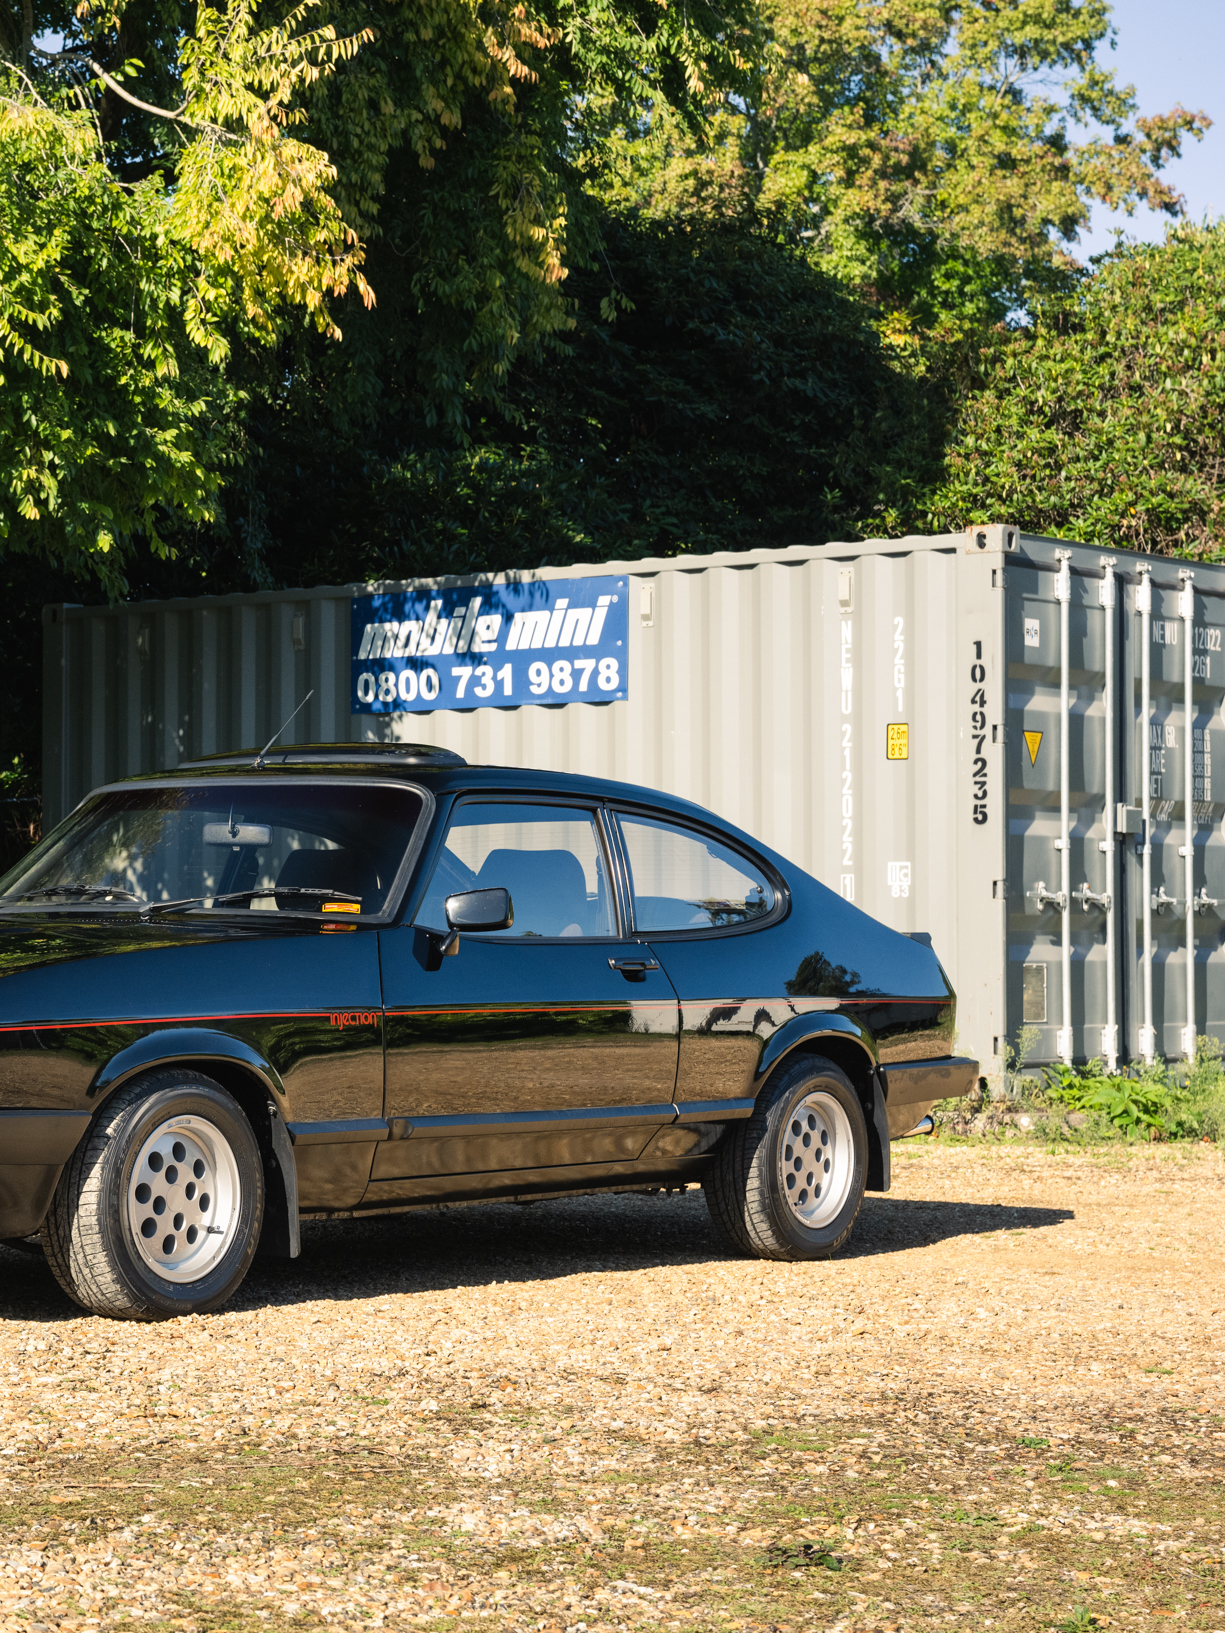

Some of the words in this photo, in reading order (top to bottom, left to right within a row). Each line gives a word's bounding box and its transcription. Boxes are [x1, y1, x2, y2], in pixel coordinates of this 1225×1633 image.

[357, 596, 503, 660] mobile
[841, 620, 853, 714] NEWU
[893, 616, 905, 712] 22G1
[1152, 621, 1178, 645] NEWU
[1191, 627, 1222, 652] 12022
[357, 667, 440, 704] 0800
[451, 663, 513, 698] 731
[528, 657, 620, 695] 9878
[970, 640, 988, 825] 10497235
[841, 723, 853, 865] 212022
[891, 884, 909, 898] 83
